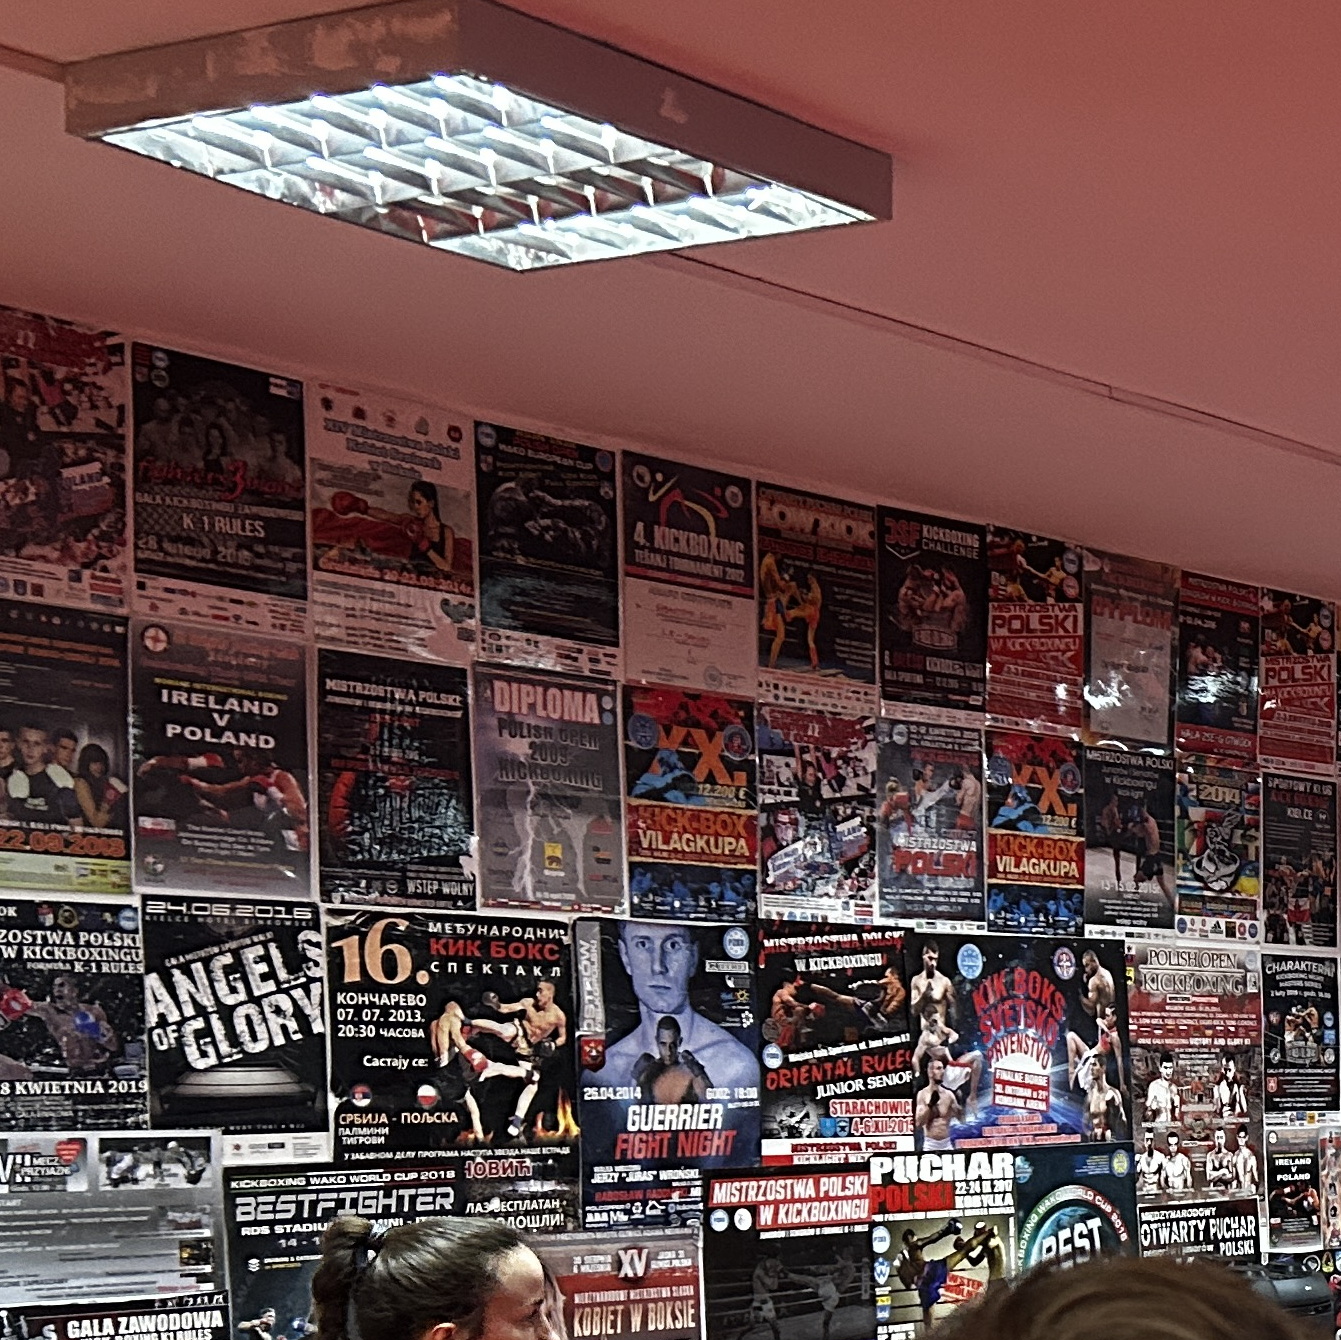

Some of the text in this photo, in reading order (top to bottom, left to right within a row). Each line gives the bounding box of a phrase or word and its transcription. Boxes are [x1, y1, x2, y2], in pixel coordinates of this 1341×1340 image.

[214, 516, 266, 538] RULES
[922, 524, 980, 550] KICKBOXING
[653, 524, 745, 565] KICKBOXING
[922, 540, 979, 560] CHALLENGE
[991, 602, 1078, 613] MISTRZOSTWA
[991, 614, 1078, 635] POLSKI
[1264, 654, 1332, 665] MISTRZOSTWA
[1264, 664, 1332, 685] POLSKI
[325, 678, 417, 700] MISTRZOSTWA
[160, 688, 279, 717] IRELAND
[492, 680, 601, 724] DIPLOMA
[212, 711, 230, 727] V
[166, 724, 276, 749] POLAND
[1086, 750, 1175, 771] MISTRZOSTWA POLSKI
[698, 784, 736, 797] 12.200
[1198, 784, 1241, 805] 2014
[637, 807, 748, 837] KICK-BOX
[1286, 806, 1314, 821] KIELCE
[996, 837, 1078, 861] KICK-BOX
[440, 879, 475, 897] WOLNY
[145, 901, 313, 920] 24.06.2016
[78, 930, 142, 947] POLSKI
[430, 937, 560, 961] КИК БОКС
[762, 932, 861, 952] MISTRZOSTWA
[1, 946, 144, 962] W KICKBOXINGU
[330, 917, 430, 986] 16.
[794, 952, 884, 972] W KICKBOXINGU
[1148, 948, 1238, 969] POLISH OPEN
[73, 961, 99, 974] K-1
[101, 961, 144, 974] RULES
[429, 961, 562, 978] СПЕКТАКЛ
[145, 930, 325, 1028] ANGELS
[1142, 972, 1245, 996] KICKBOXING
[336, 992, 427, 1008] КОНЧАРЕВО
[151, 982, 325, 1070] OF GLORY
[336, 1008, 426, 1023] 07. 07. 2013.
[337, 1024, 425, 1039] 20:30 ЧАСОВА
[362, 1054, 429, 1071] Састају се:
[765, 1058, 857, 1092] ORIENTAL
[14, 1080, 148, 1095] KWIETNIA 2019
[583, 1086, 642, 1100] 26.04.2014
[815, 1080, 866, 1100] JUNIOR
[338, 1111, 459, 1126] СРБИЈА ПОЉСКА
[626, 1103, 724, 1131] GUERRIER
[341, 1135, 386, 1146] ТИГРОВИ
[614, 1129, 737, 1160] FIGHT NIGHT
[869, 1152, 1015, 1185] PUCHAR
[1274, 1157, 1312, 1167] IRELAND
[230, 1169, 456, 1189] KICKBOXING WAKO WORLD CUP 2018
[1276, 1171, 1311, 1182] POLAND
[712, 1180, 817, 1204] MISTRZOSTWA
[818, 1174, 869, 1198] POLSKI
[870, 1182, 955, 1217] POLSKI
[234, 1187, 456, 1222] BESTFIGHTER
[759, 1199, 870, 1226] W KICKBOXINGU
[240, 1226, 271, 1237] RDS
[1040, 1216, 1104, 1266] BEST
[1140, 1214, 1256, 1247] OTWARTY PUCHAR
[1219, 1239, 1255, 1257] POLSKI
[617, 1247, 650, 1279] XV
[66, 1318, 114, 1339] GALA
[117, 1309, 225, 1337] ZAWODOWA
[573, 1299, 697, 1339] KOBIET W BOKSIE
